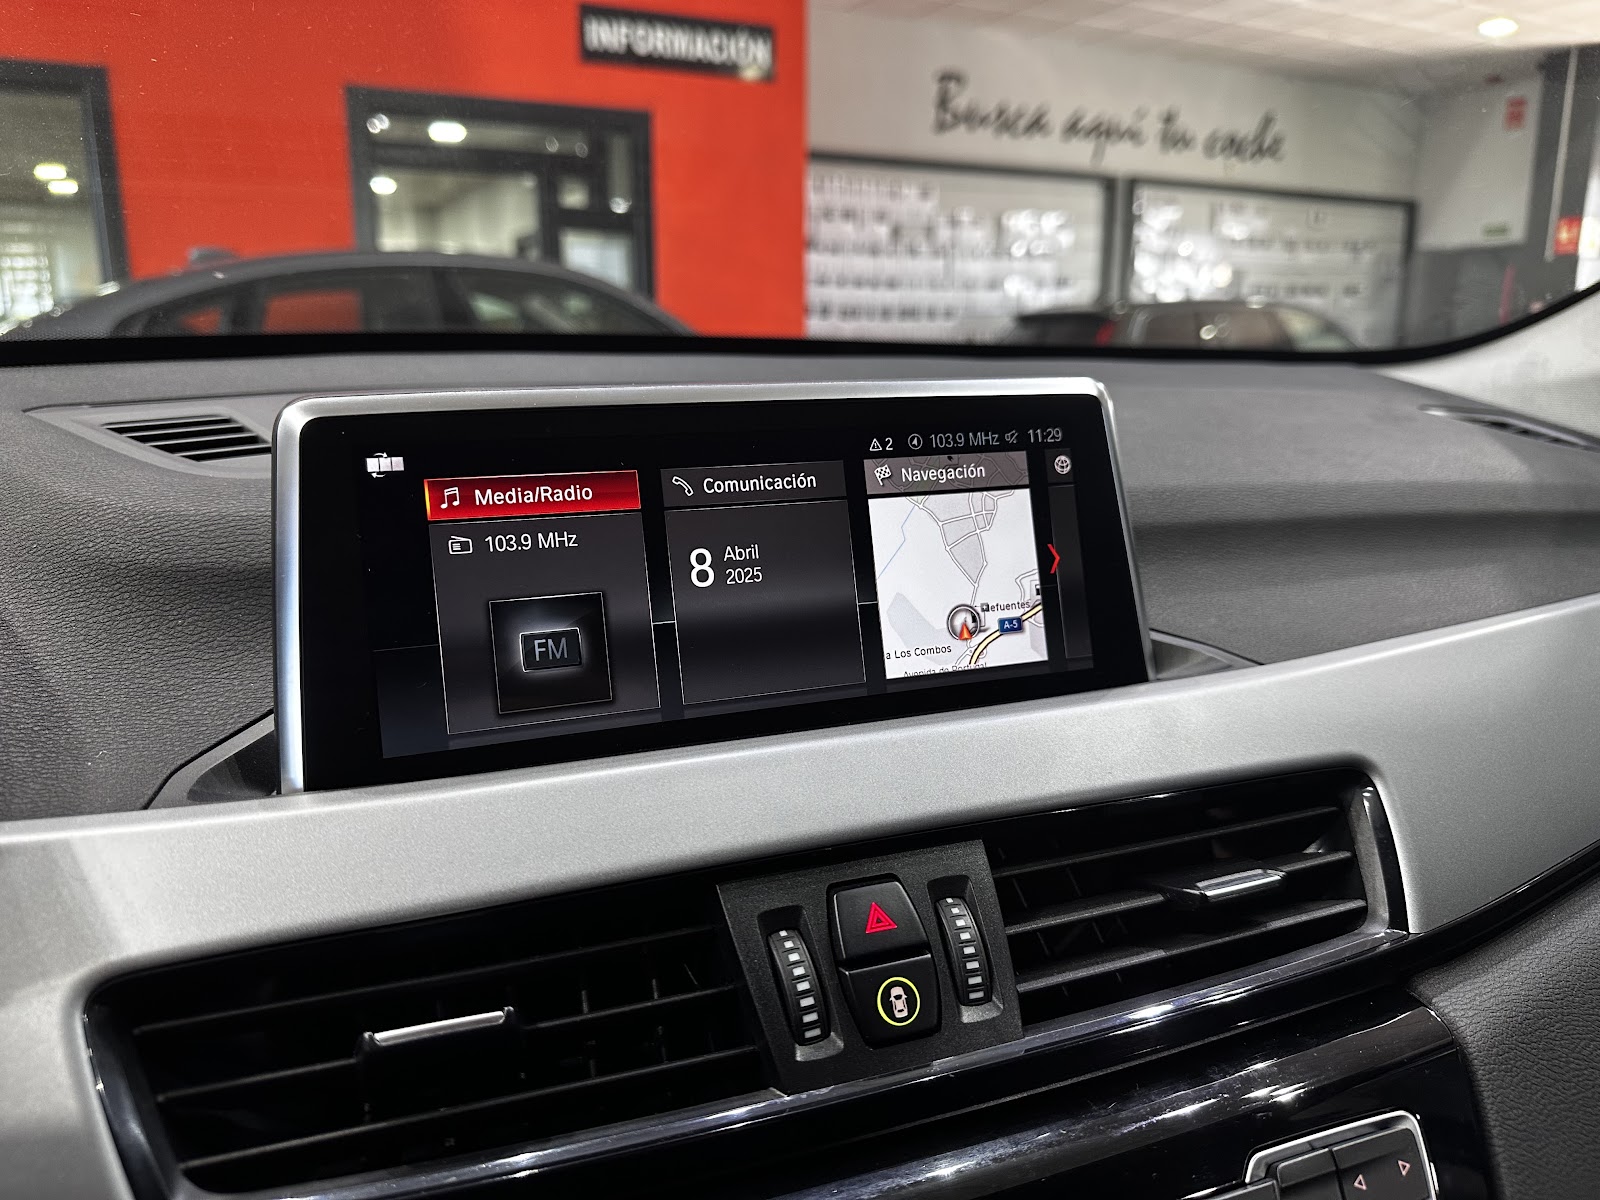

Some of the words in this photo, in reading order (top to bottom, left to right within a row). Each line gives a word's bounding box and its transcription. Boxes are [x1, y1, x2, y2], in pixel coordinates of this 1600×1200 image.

[583, 15, 772, 68] INFORMACIÓN
[934, 70, 1051, 138] Busca
[1157, 105, 1197, 155] tu
[885, 437, 894, 451] 2
[929, 432, 965, 448] 103.9
[969, 431, 1000, 447] MHz
[1027, 428, 1063, 443] 11:29
[703, 472, 817, 494] Comunicación
[901, 463, 986, 483] Navegación
[474, 484, 593, 506] Media/Radio
[484, 532, 532, 553] 103.9
[537, 531, 579, 550] MHz
[723, 543, 760, 562] Abril
[689, 547, 716, 588] 8
[725, 566, 763, 585] 2025
[1003, 619, 1018, 630] A-5
[533, 637, 569, 661] FM
[894, 649, 912, 659] Los
[914, 645, 952, 657] Combos
